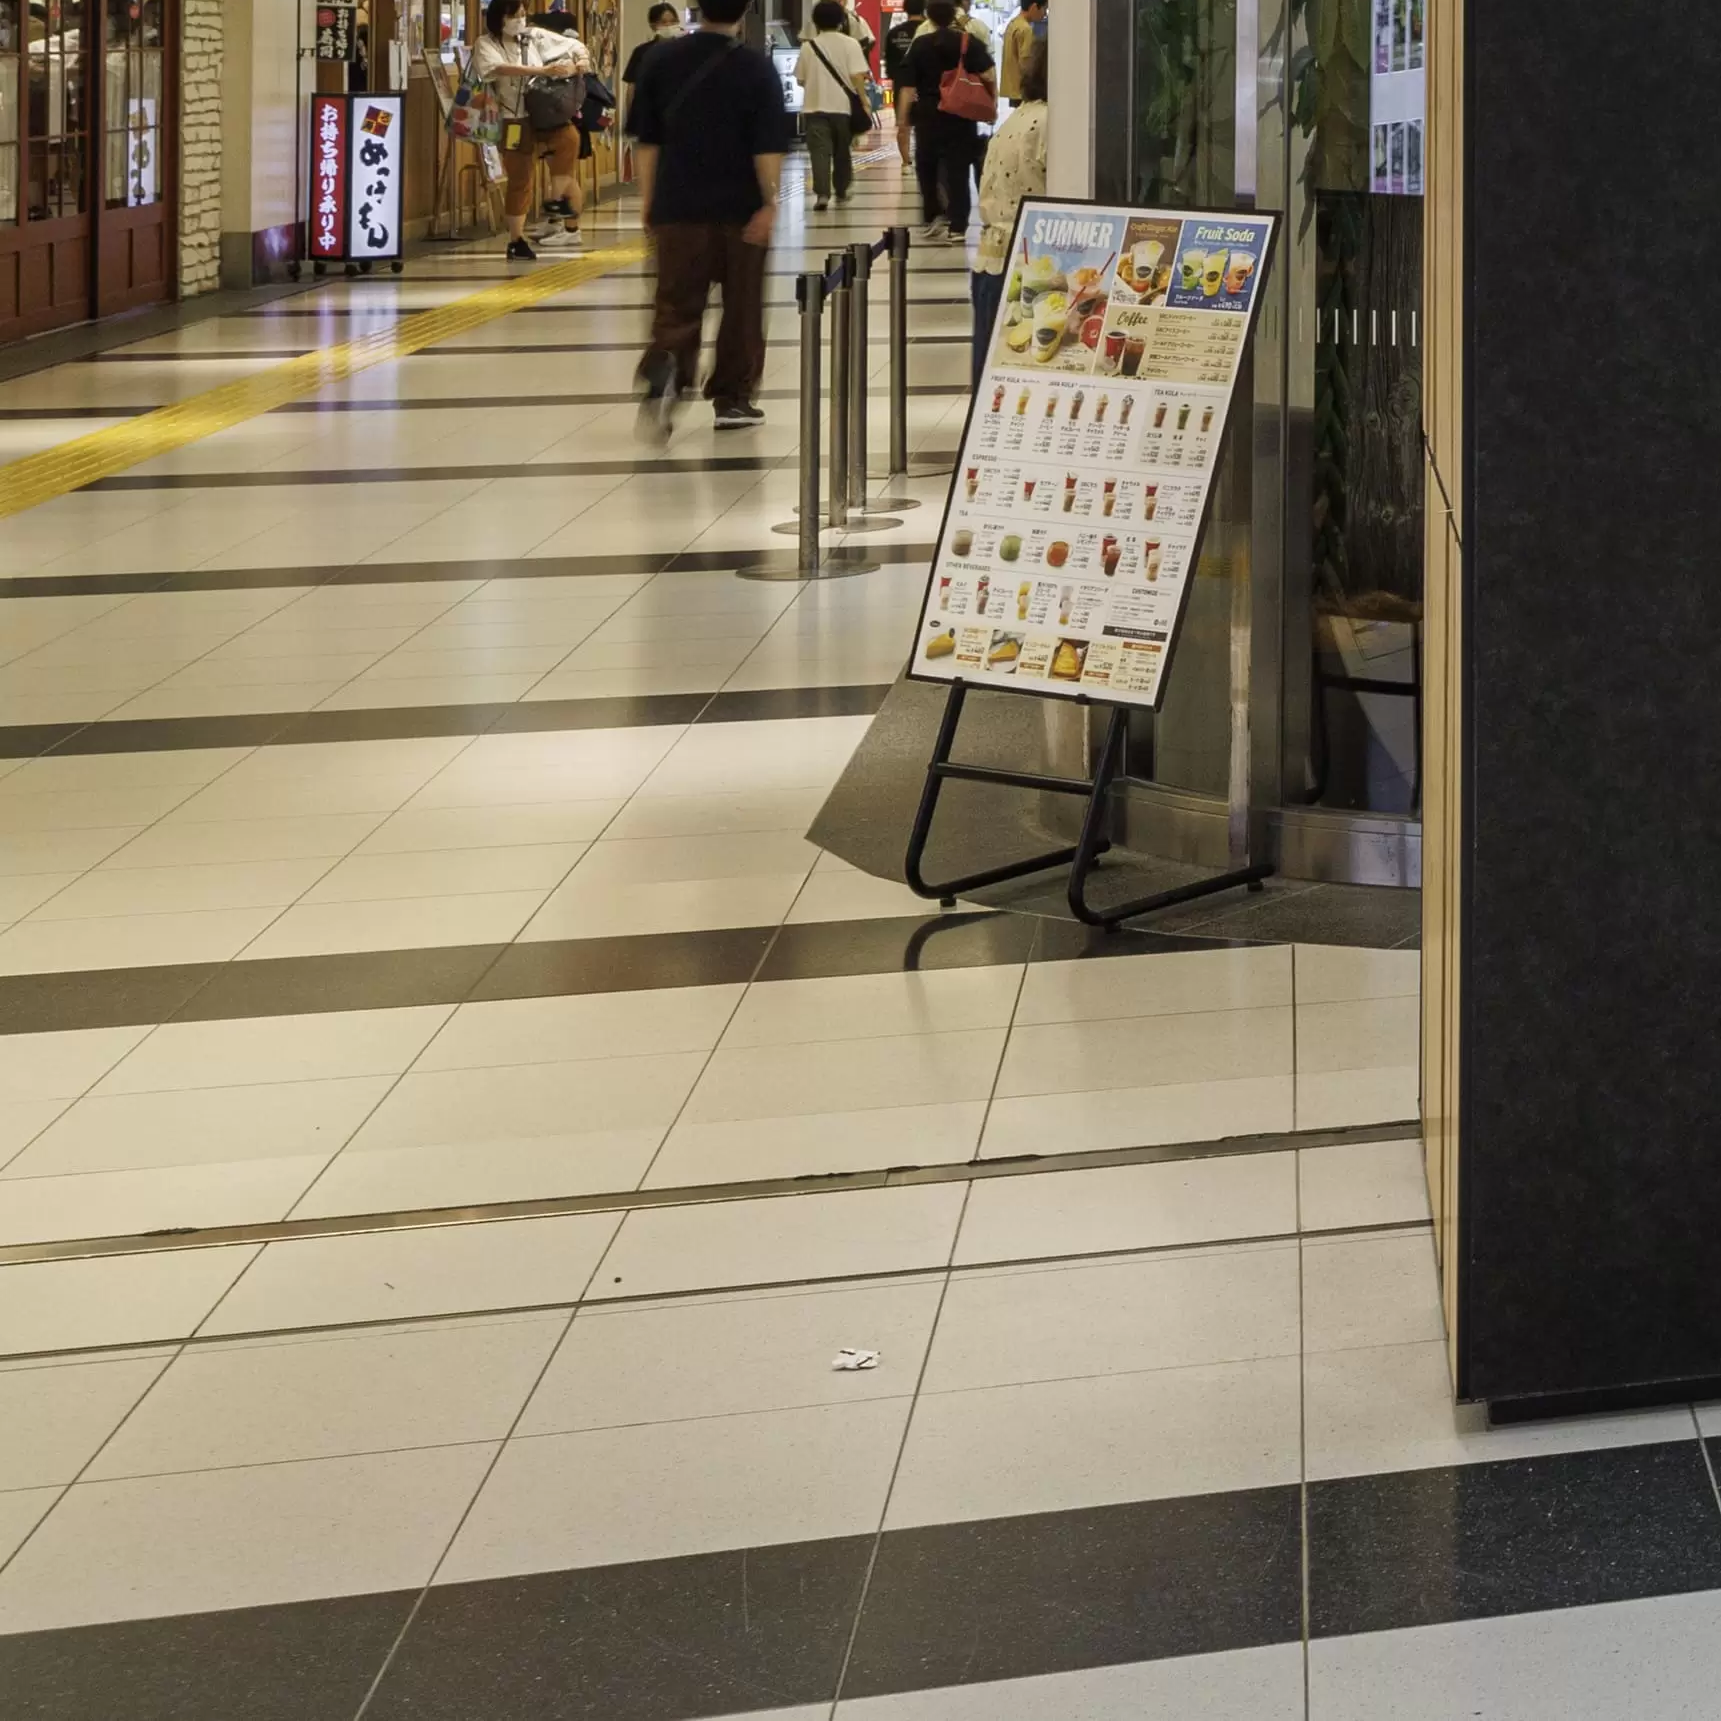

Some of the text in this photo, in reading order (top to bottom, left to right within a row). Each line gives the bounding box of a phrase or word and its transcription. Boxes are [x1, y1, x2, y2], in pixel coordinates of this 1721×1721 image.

[1032, 218, 1113, 248] SUMMER
[1195, 226, 1256, 242] Fruit Soda
[1116, 311, 1149, 326] Coffee
